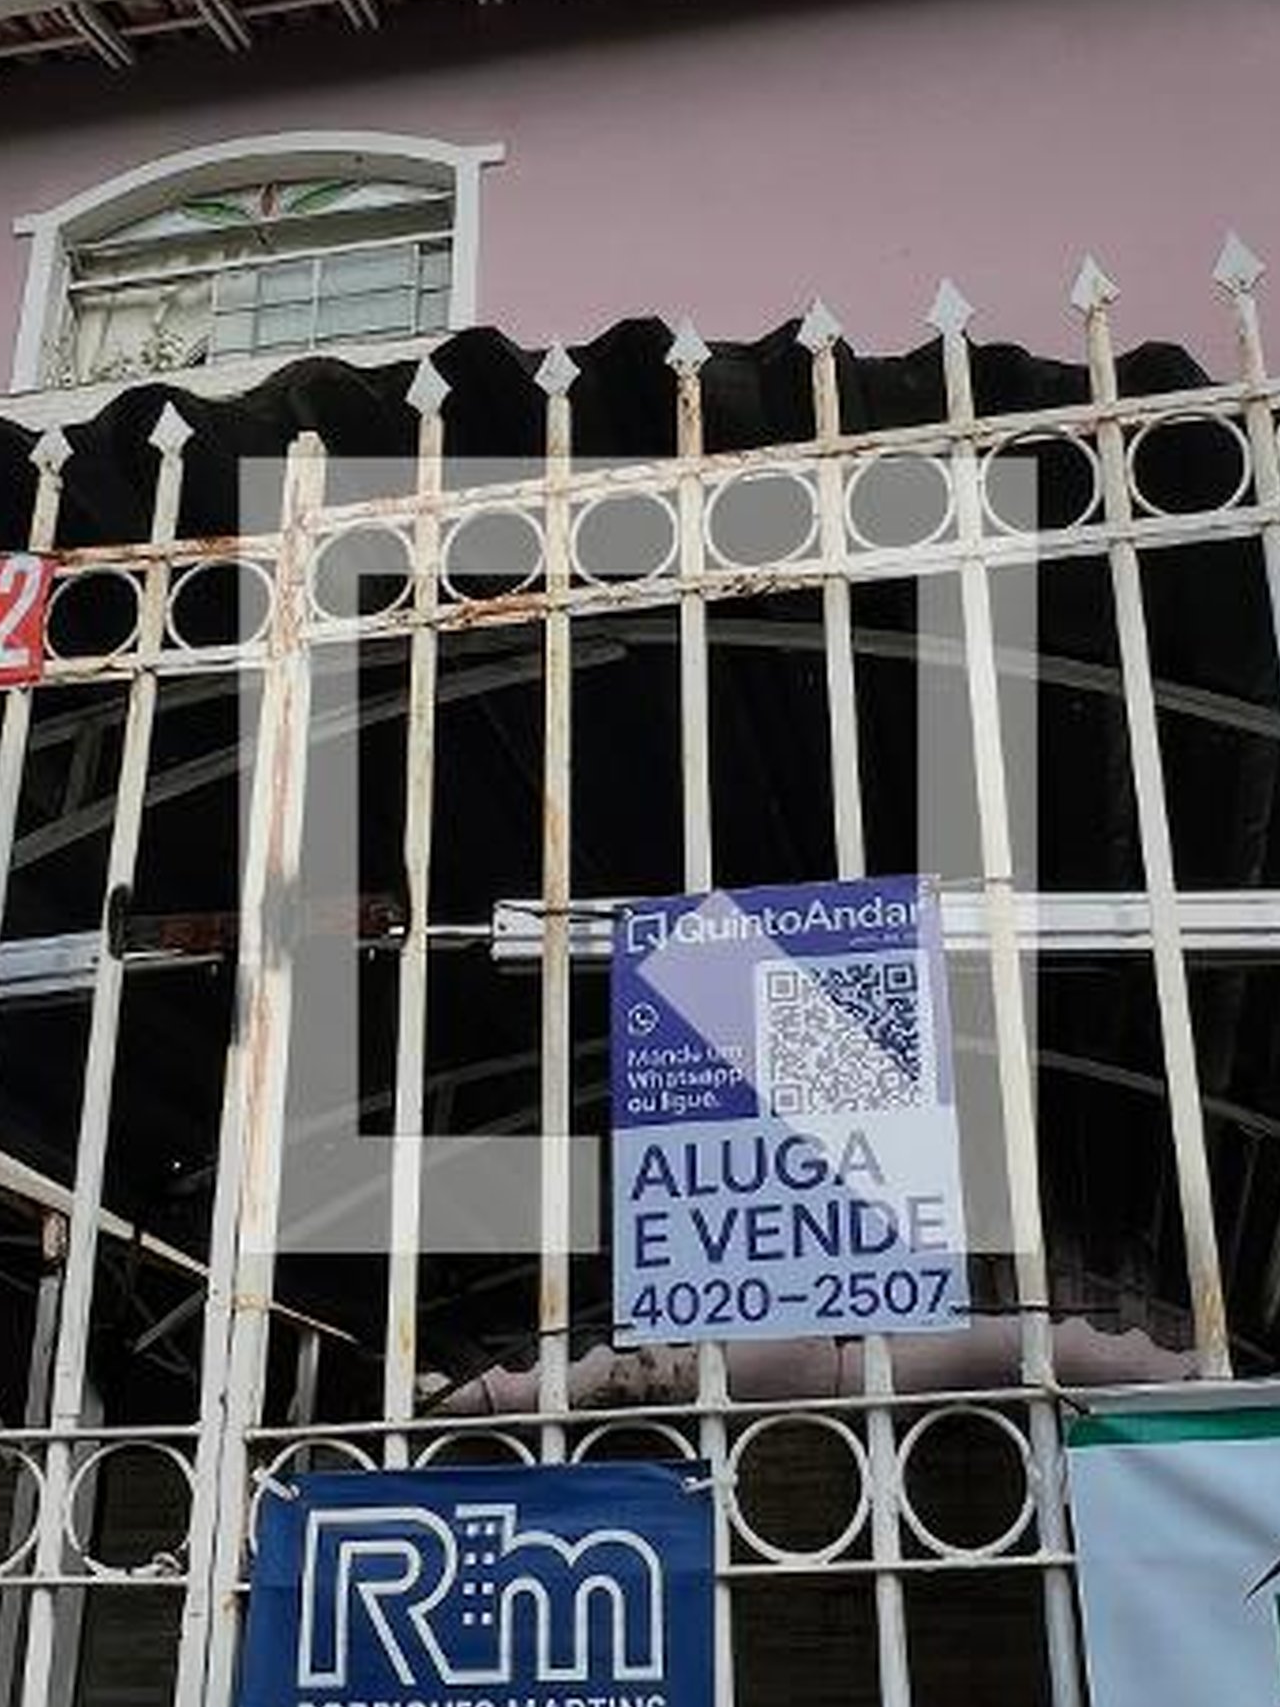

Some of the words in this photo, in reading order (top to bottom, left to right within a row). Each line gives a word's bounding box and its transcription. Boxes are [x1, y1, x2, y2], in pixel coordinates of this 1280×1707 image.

[673, 895, 926, 945] QuintoAndar
[630, 1131, 886, 1201] ALUGA
[634, 1211, 671, 1270] E
[690, 1196, 950, 1263] VENDE
[631, 1269, 953, 1327] 4020-2507
